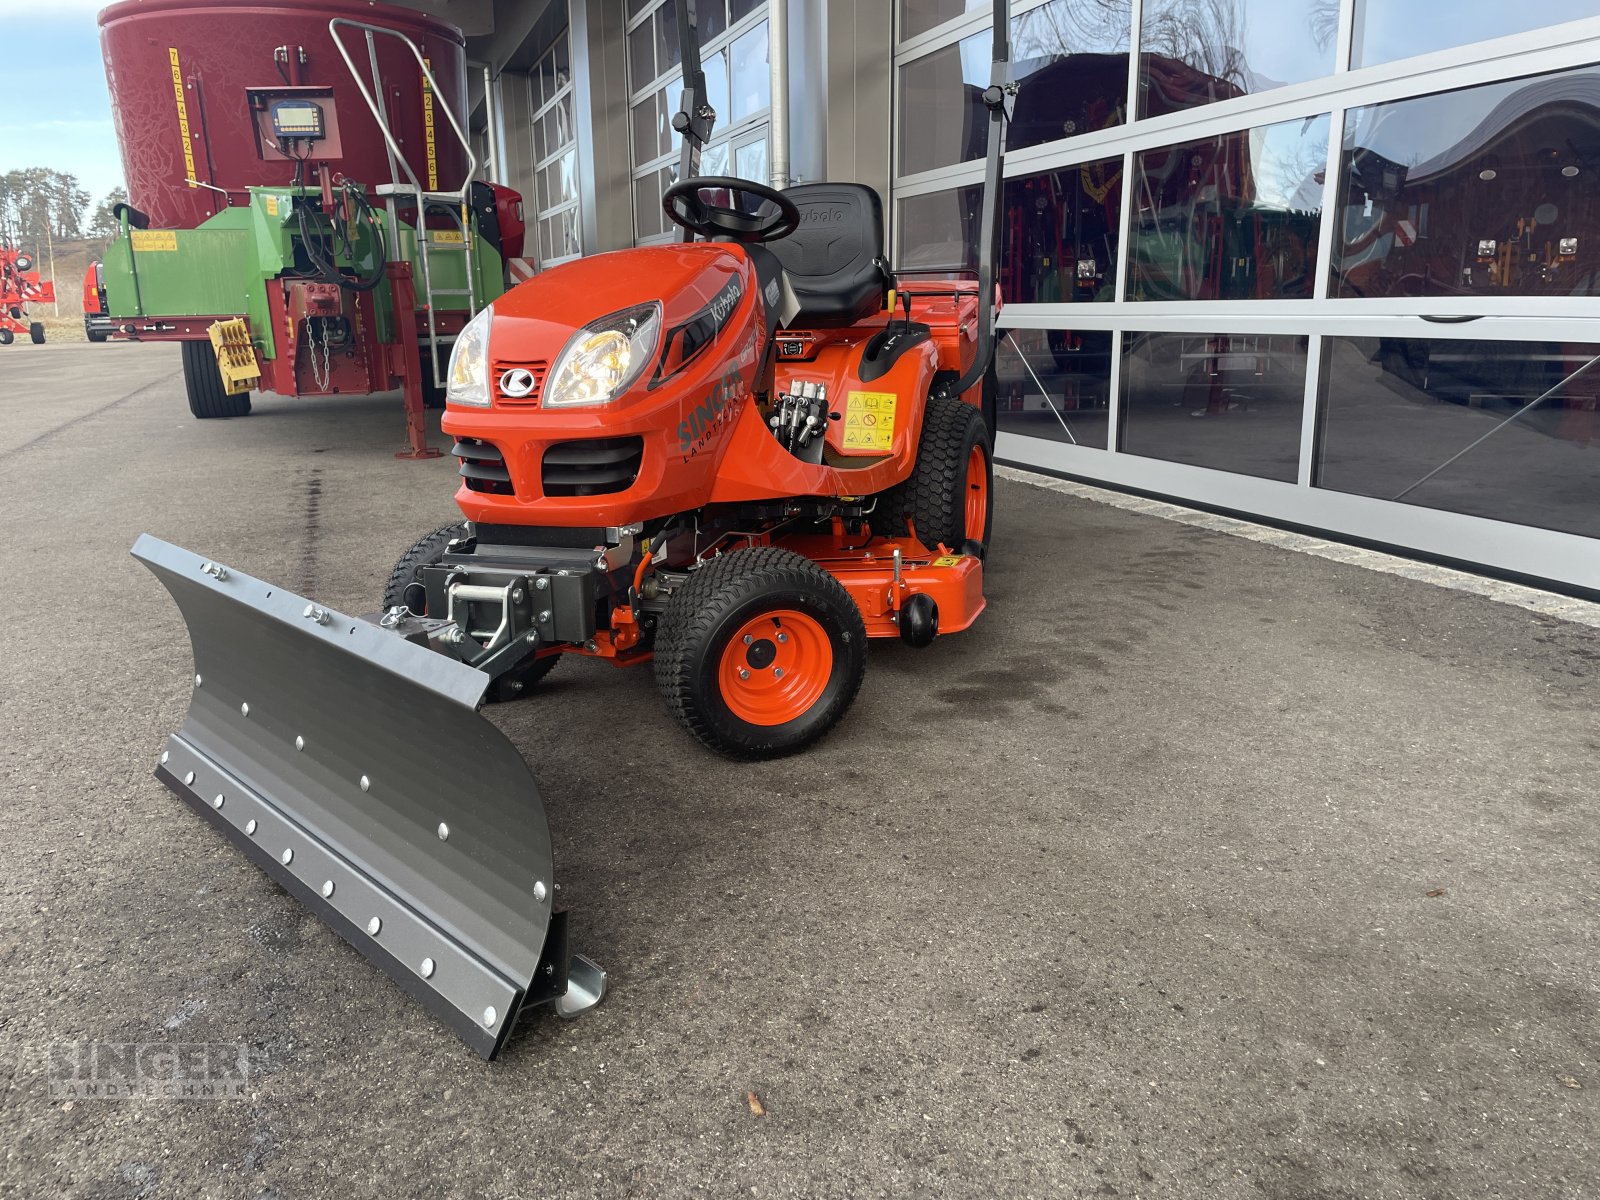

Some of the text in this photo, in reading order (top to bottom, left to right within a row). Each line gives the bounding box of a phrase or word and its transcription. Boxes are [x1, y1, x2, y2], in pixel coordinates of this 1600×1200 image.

[170, 52, 177, 62] 7
[173, 69, 180, 80] 6
[176, 87, 183, 98] 5
[425, 96, 431, 106] 2
[179, 106, 185, 116] 4
[426, 114, 432, 123] 3
[181, 123, 188, 133] 3
[427, 130, 433, 139] 4
[184, 141, 191, 151] 2
[428, 146, 434, 156] 5
[429, 162, 435, 171] 6
[430, 178, 436, 188] 7
[799, 207, 843, 223] ubota
[710, 283, 741, 322] Kubota
[677, 359, 744, 452] SINGER
